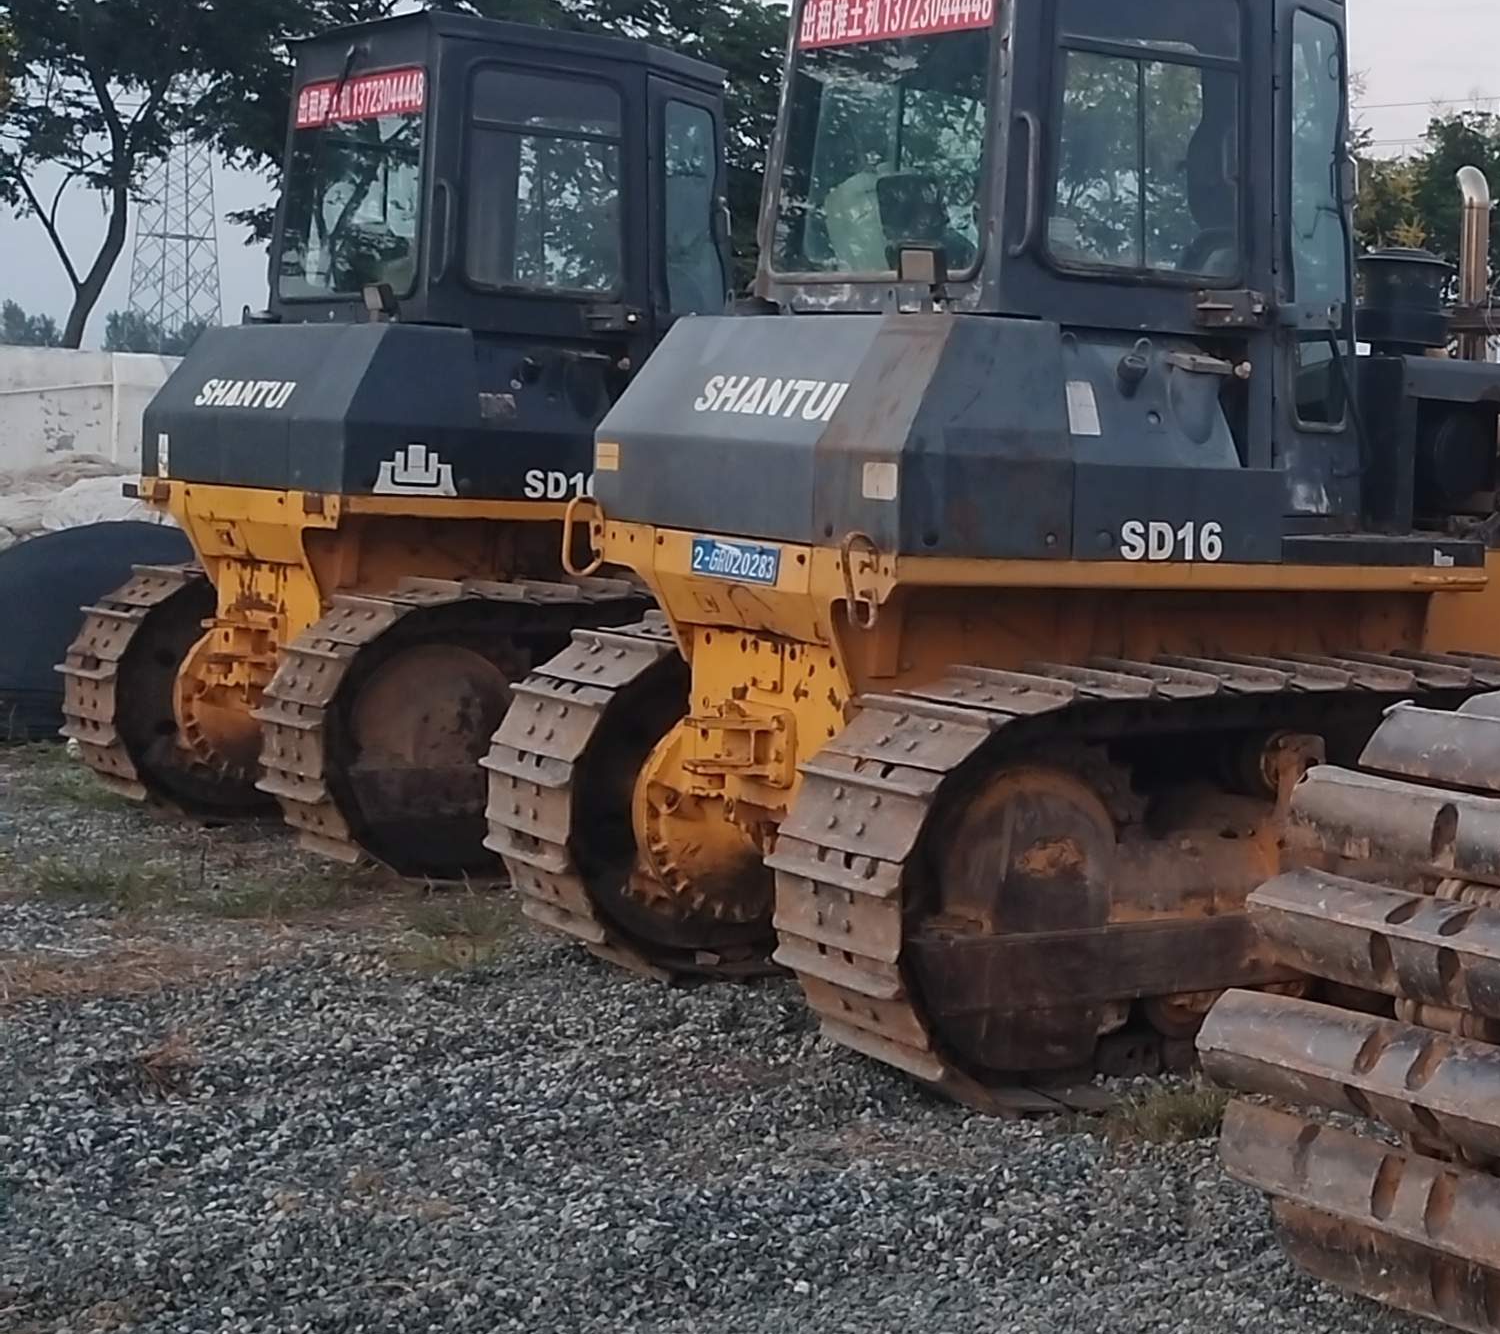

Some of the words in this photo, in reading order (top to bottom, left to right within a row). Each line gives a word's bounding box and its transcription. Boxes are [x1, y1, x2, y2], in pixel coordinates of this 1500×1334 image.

[352, 72, 424, 116] 13723044448
[194, 378, 297, 409] SHANTUI
[694, 375, 850, 422] SHANTUI
[1120, 520, 1223, 562] SD16
